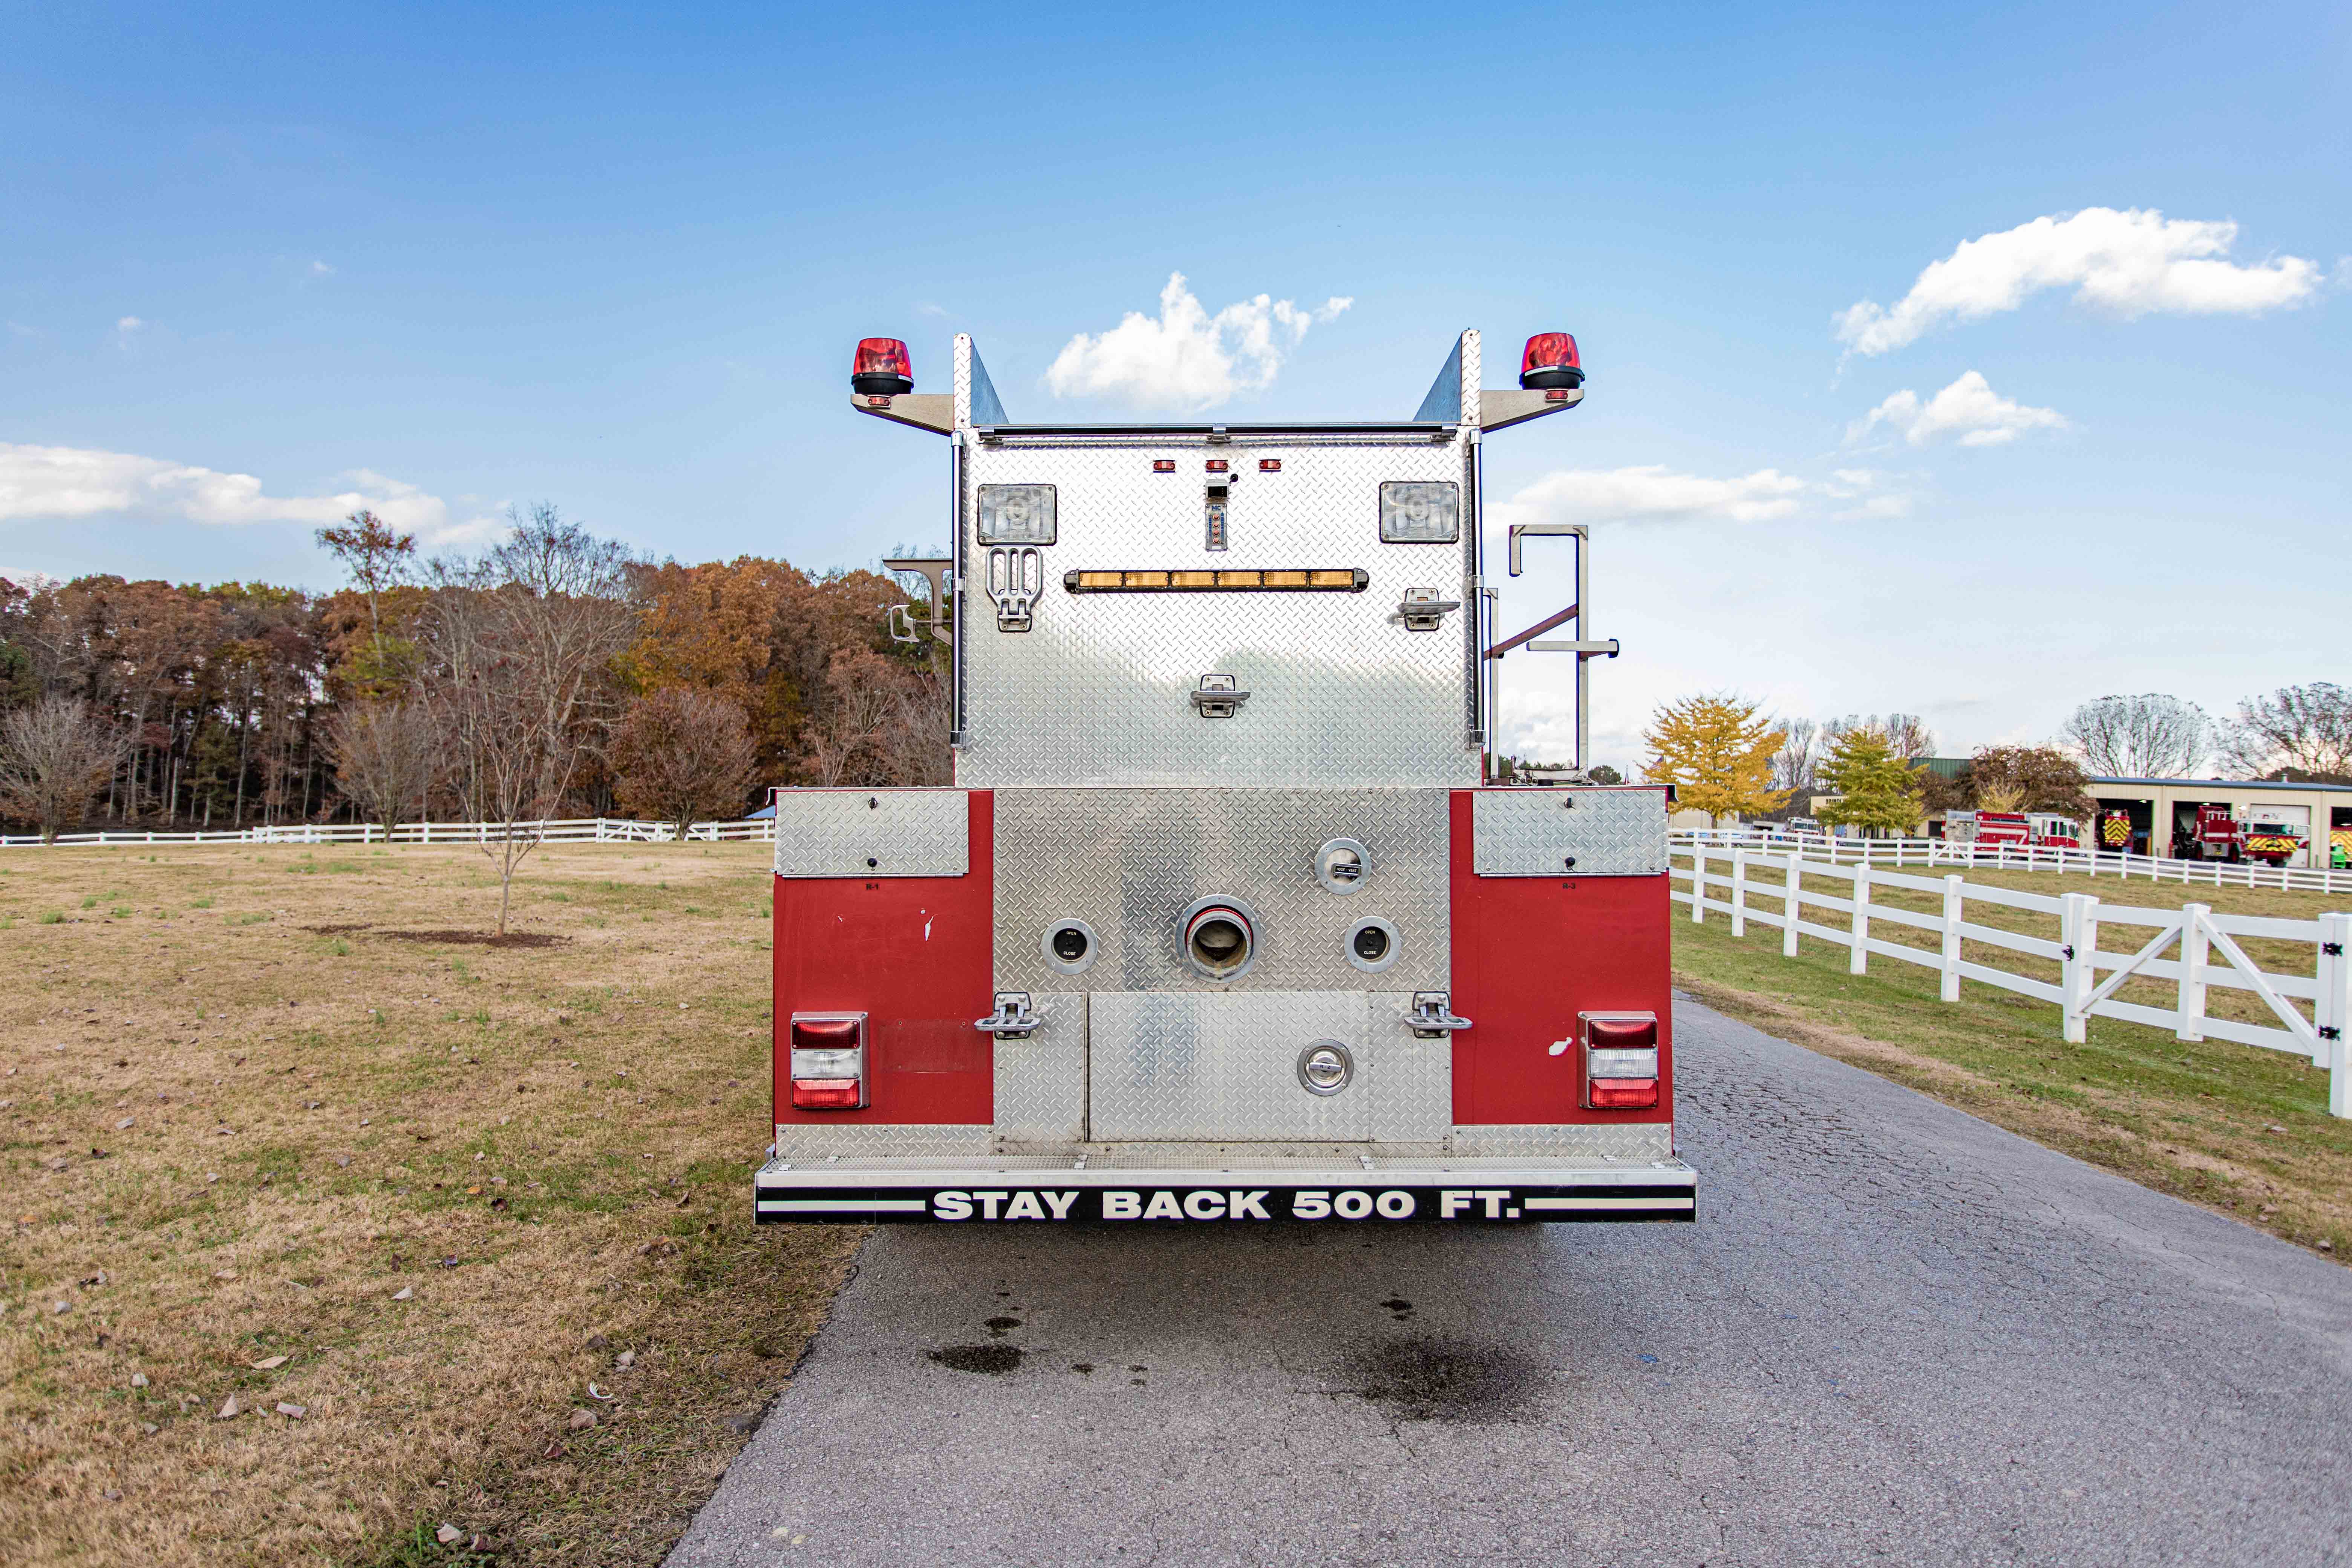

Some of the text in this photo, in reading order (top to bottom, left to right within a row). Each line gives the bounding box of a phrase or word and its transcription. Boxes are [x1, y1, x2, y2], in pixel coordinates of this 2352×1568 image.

[933, 1190, 1519, 1219] STAY BACK 500 FT.
